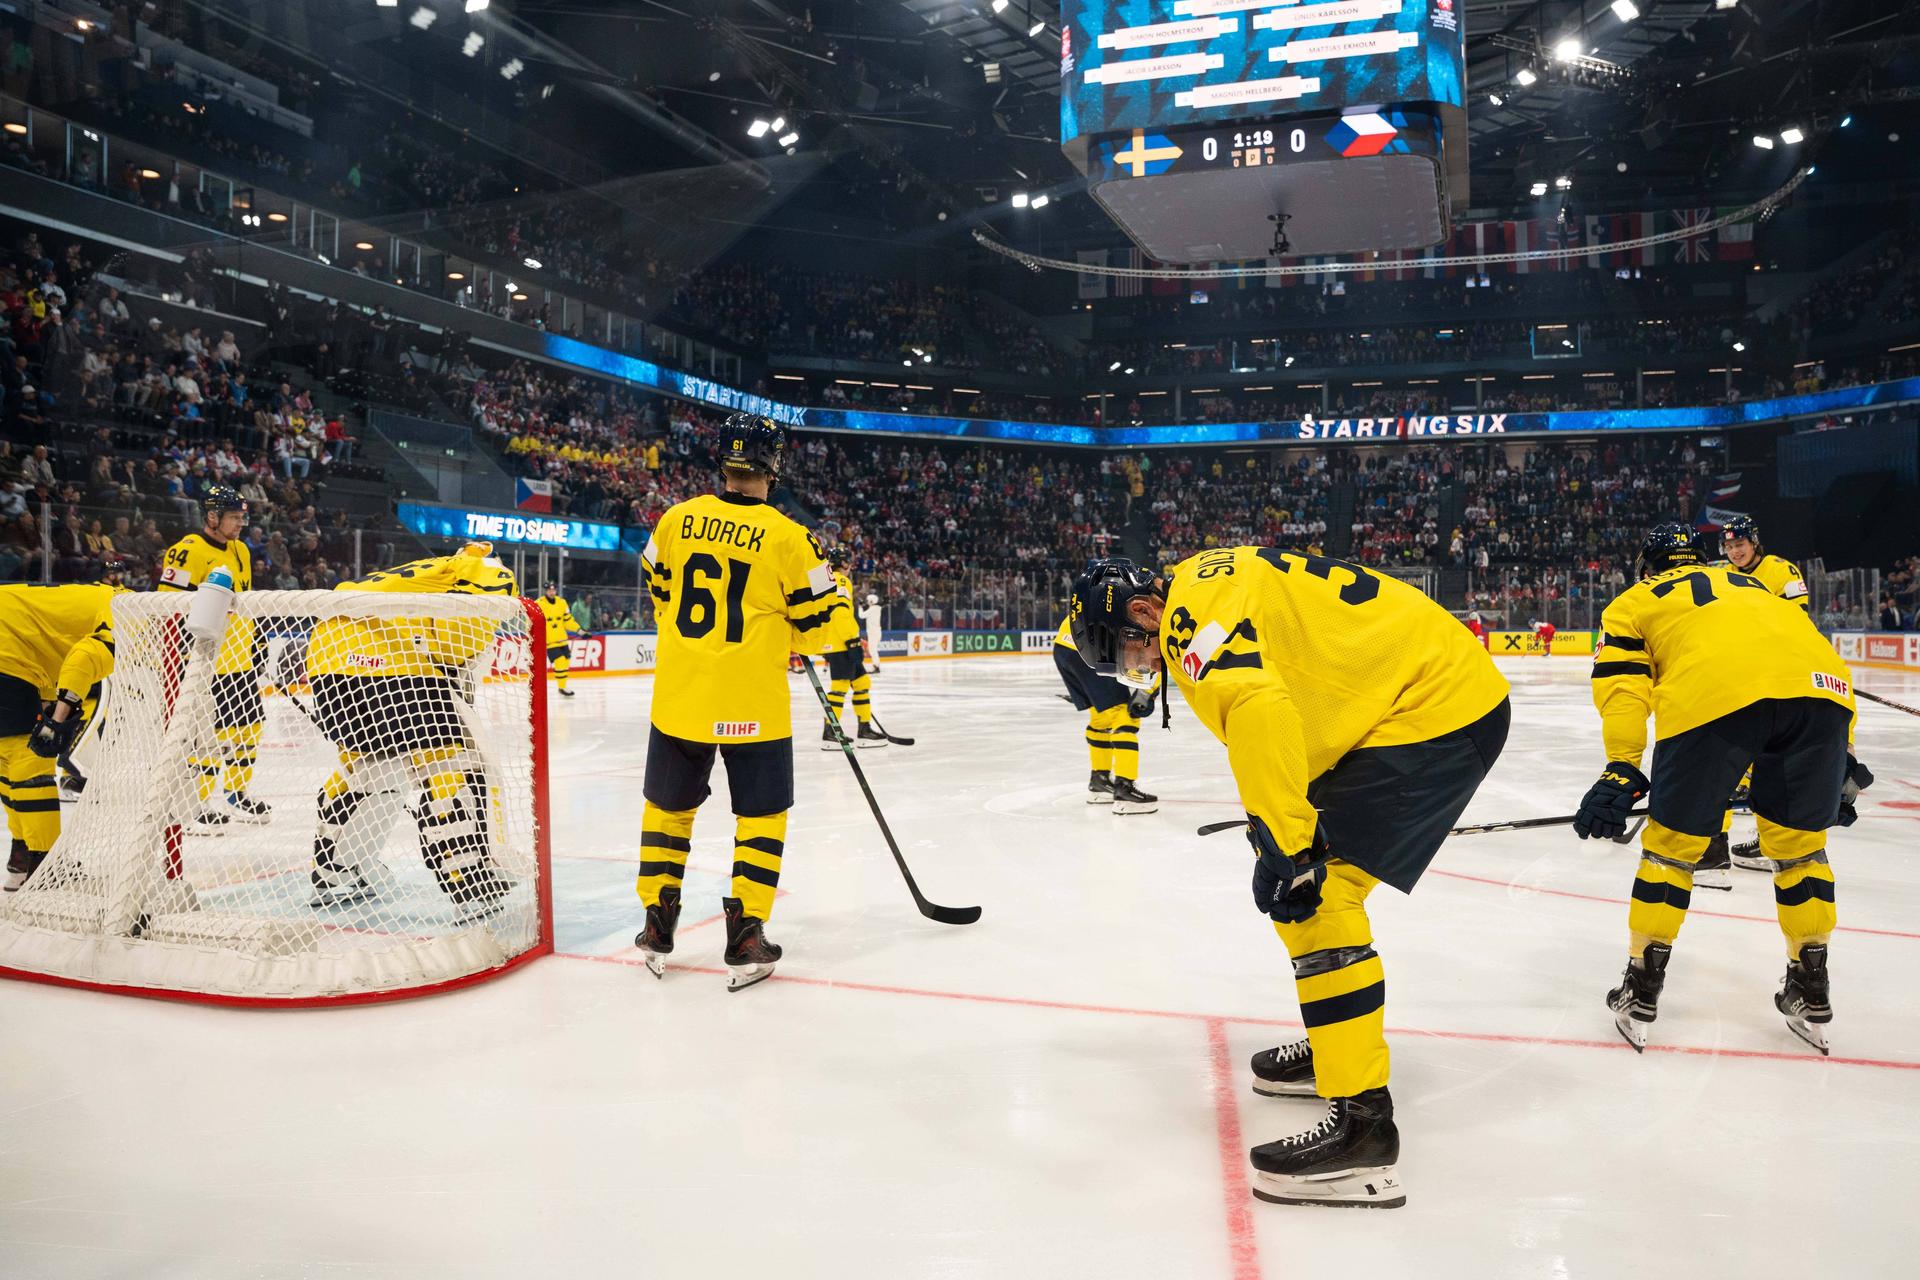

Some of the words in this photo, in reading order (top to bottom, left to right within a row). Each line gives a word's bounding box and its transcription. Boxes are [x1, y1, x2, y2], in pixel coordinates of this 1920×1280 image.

[1318, 8, 1359, 18] KARLSSON
[1309, 44, 1342, 53] MATTIAS
[1343, 40, 1376, 51] EKHOLM
[1148, 63, 1182, 72] LARSSON
[1211, 90, 1243, 98] MAGNUS
[1245, 86, 1282, 96] HELLBERG
[1234, 130, 1273, 147] 1:19
[1291, 129, 1305, 152] 0
[1203, 137, 1217, 161] 0
[683, 375, 772, 418] STARTING
[772, 401, 807, 426] SIX
[1299, 416, 1449, 439] STARTING
[1455, 413, 1508, 435] SIX
[732, 440, 743, 450] 61
[467, 513, 504, 537] TIME
[504, 517, 526, 539] TO
[525, 521, 570, 544] SHINE
[681, 514, 766, 553] BJORCK
[1673, 533, 1688, 543] 74
[168, 548, 189, 567] 94
[675, 552, 752, 643] 61
[1105, 584, 1114, 614] CCM
[956, 635, 1014, 651] SKODA
[1027, 635, 1057, 648] IIH
[636, 644, 657, 664] Sw
[1824, 675, 1848, 695] IIHF
[726, 723, 756, 735] IIHF
[1612, 989, 1634, 1011] CCM
